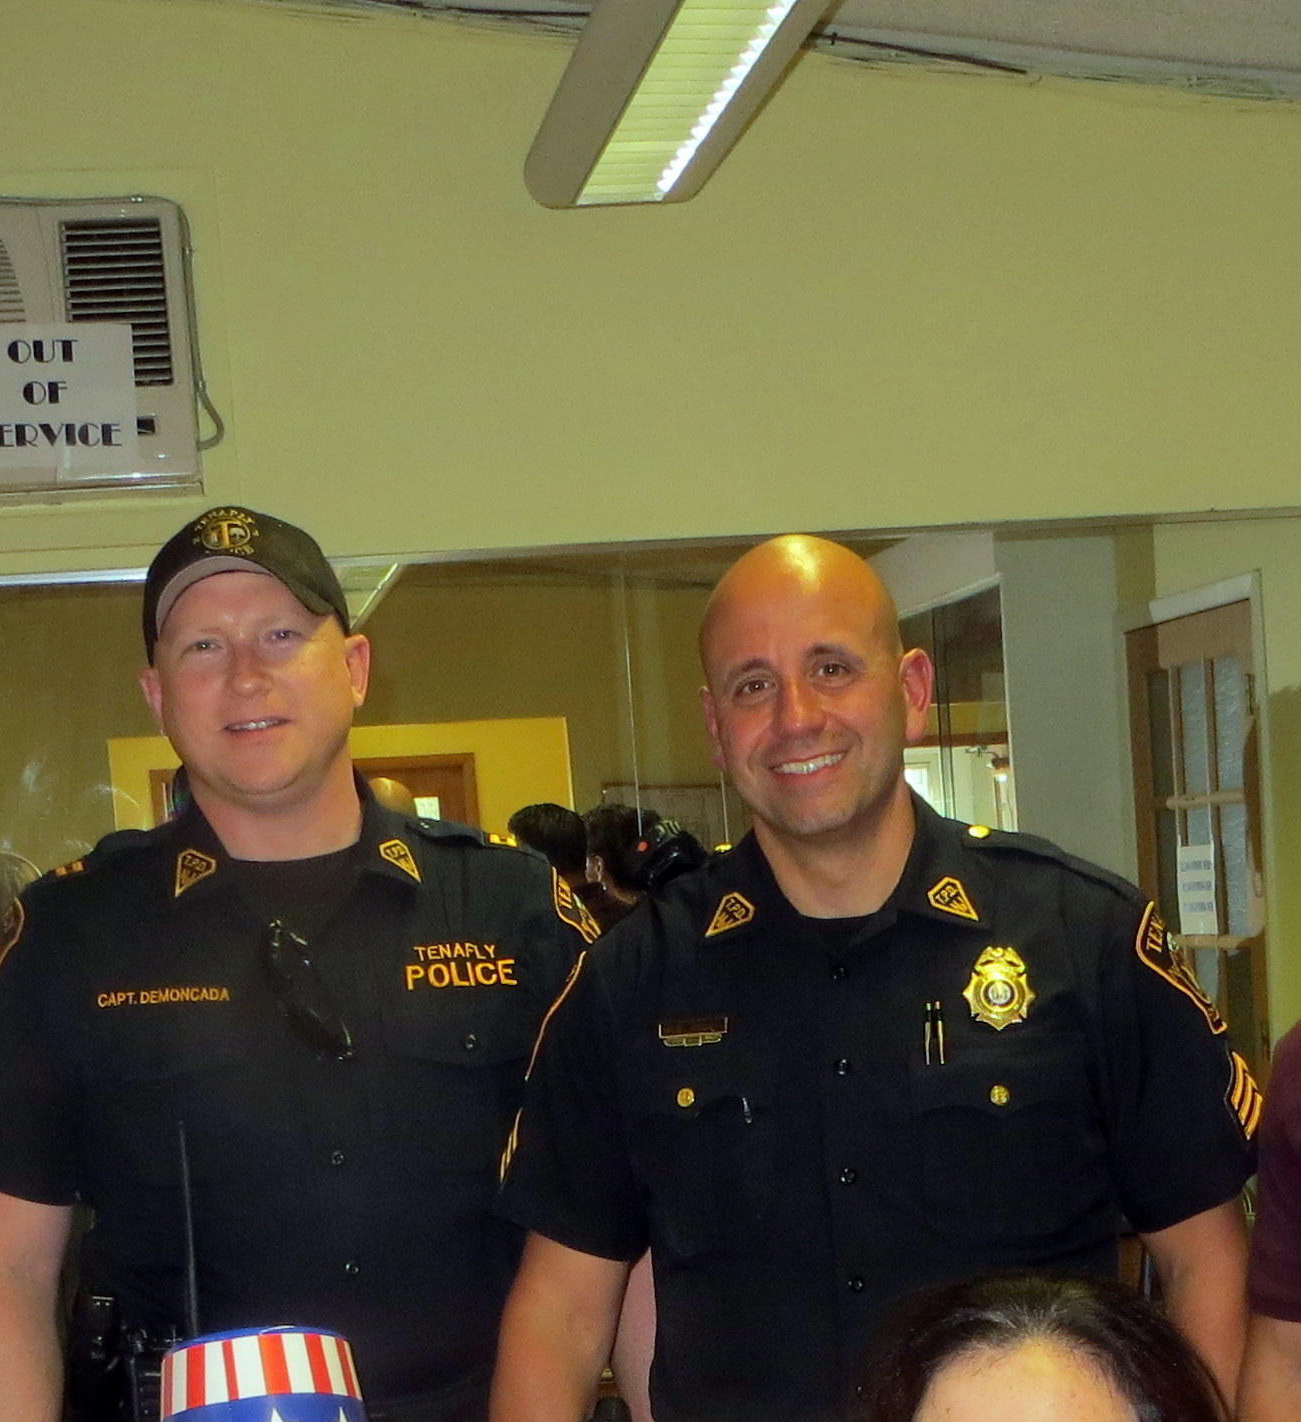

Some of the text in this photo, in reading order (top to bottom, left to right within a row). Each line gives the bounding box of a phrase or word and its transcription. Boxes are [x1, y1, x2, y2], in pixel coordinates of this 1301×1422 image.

[7, 339, 78, 364] OUT
[22, 381, 68, 405] OF
[413, 942, 496, 961] TENAFLY
[406, 959, 518, 990] POLICE
[97, 987, 230, 1007] CAPT. DEMONCADA
